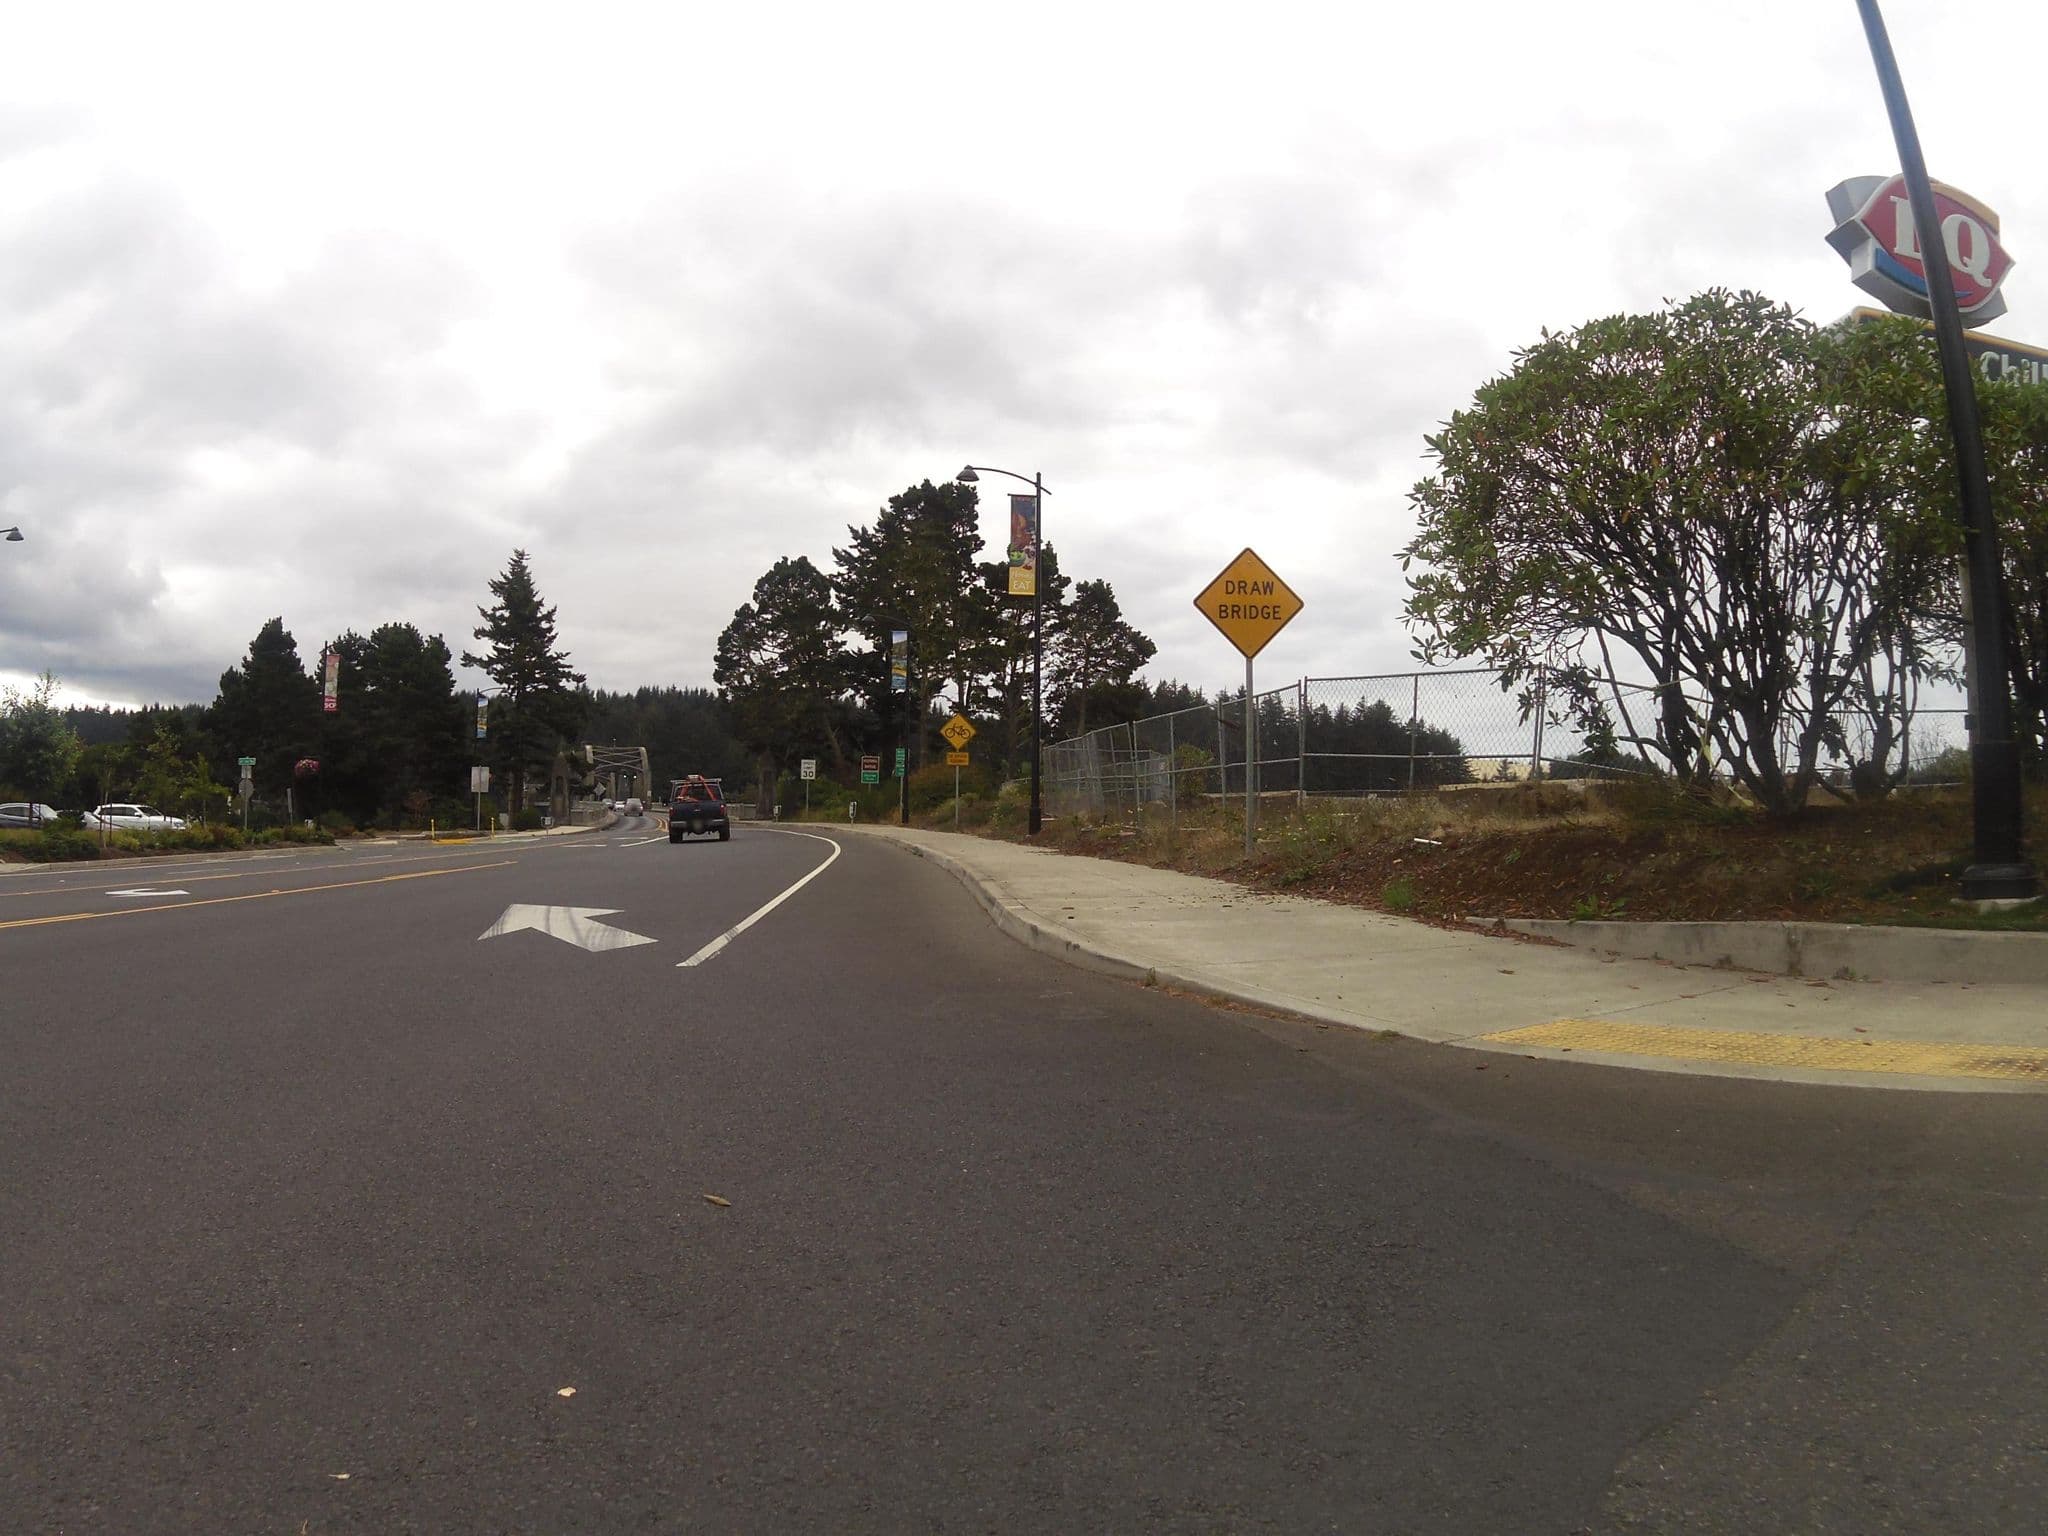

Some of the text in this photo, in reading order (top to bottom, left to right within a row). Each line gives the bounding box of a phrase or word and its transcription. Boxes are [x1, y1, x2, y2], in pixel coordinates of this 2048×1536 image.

[1225, 580, 1274, 595] DRAW
[1218, 604, 1281, 620] BRIDGE
[803, 770, 814, 778] 30
